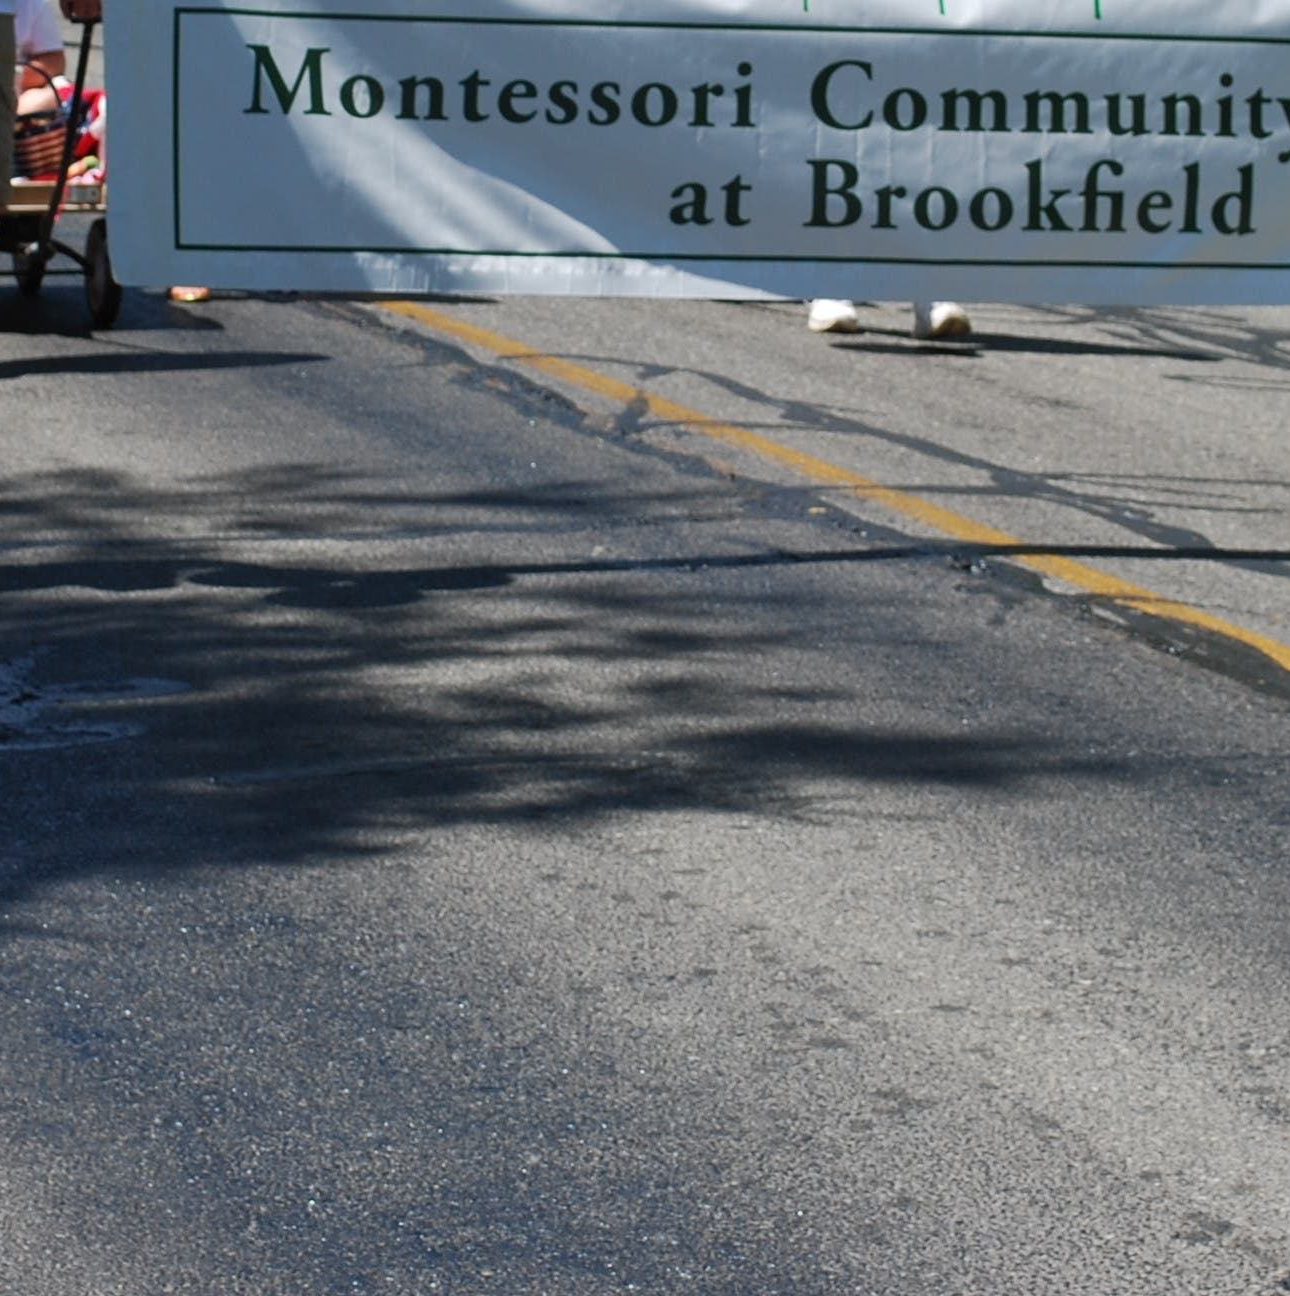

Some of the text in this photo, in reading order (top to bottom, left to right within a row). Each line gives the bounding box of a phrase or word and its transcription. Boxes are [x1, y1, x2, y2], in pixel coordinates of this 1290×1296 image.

[242, 43, 757, 128] Montessori
[668, 158, 1257, 237] at Brookfield
